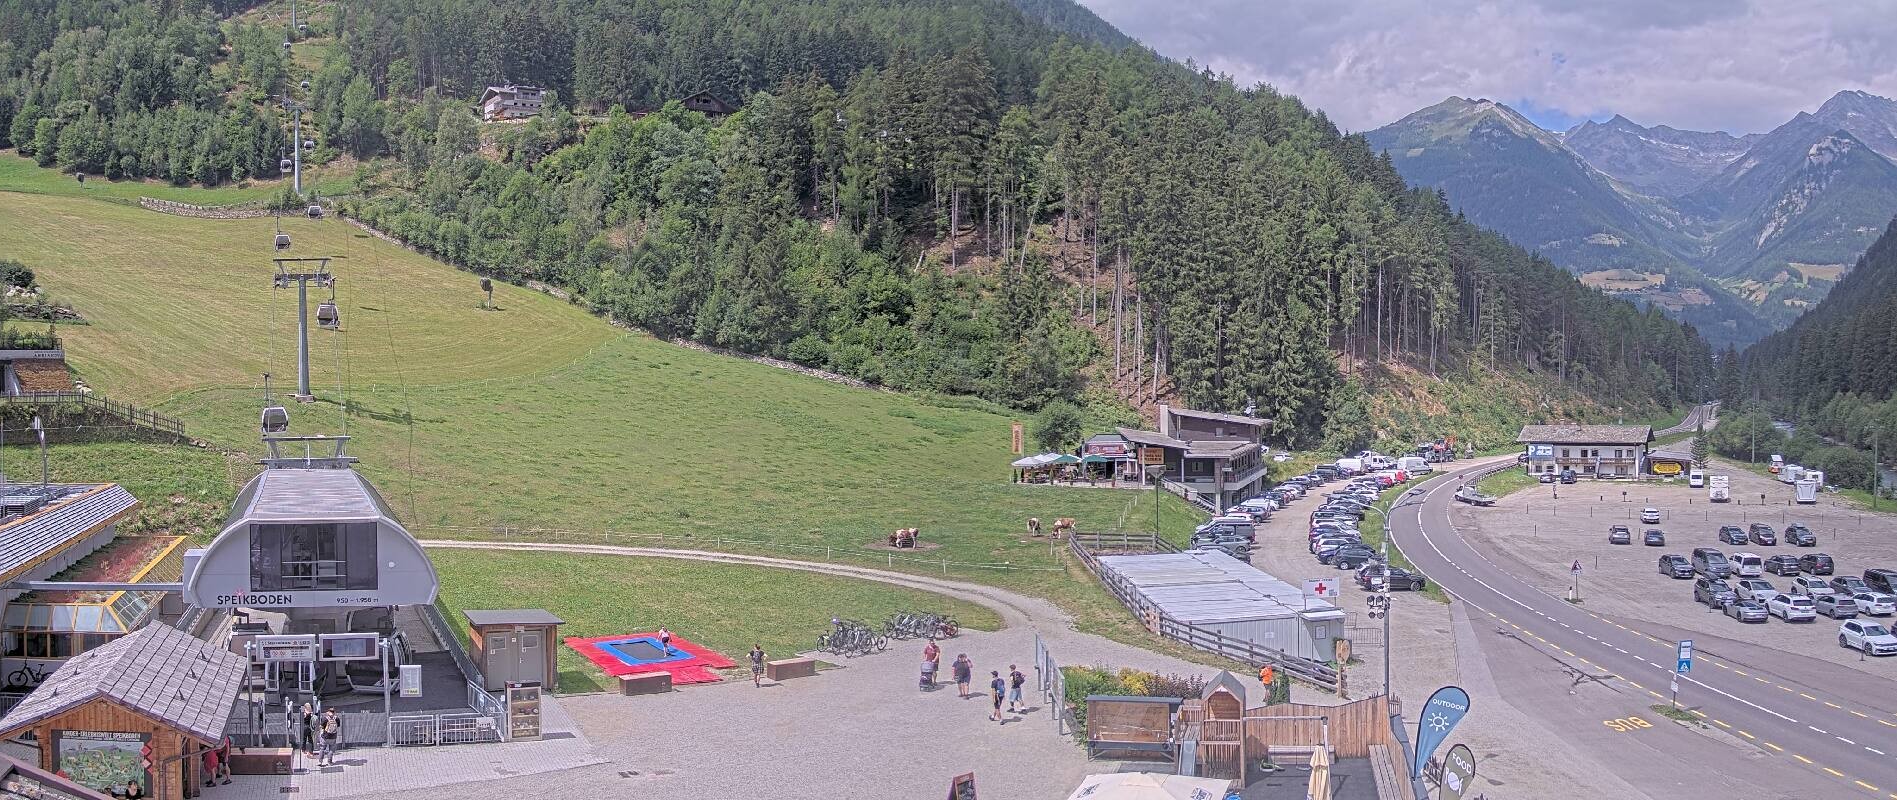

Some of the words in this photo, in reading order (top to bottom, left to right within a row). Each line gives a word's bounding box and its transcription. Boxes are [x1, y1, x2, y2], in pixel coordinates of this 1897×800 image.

[217, 595, 292, 605] SPEIKBODEN
[1432, 698, 1466, 711] OUTDOOR
[1603, 716, 1654, 732] BUS
[1452, 752, 1472, 774] FOOD
